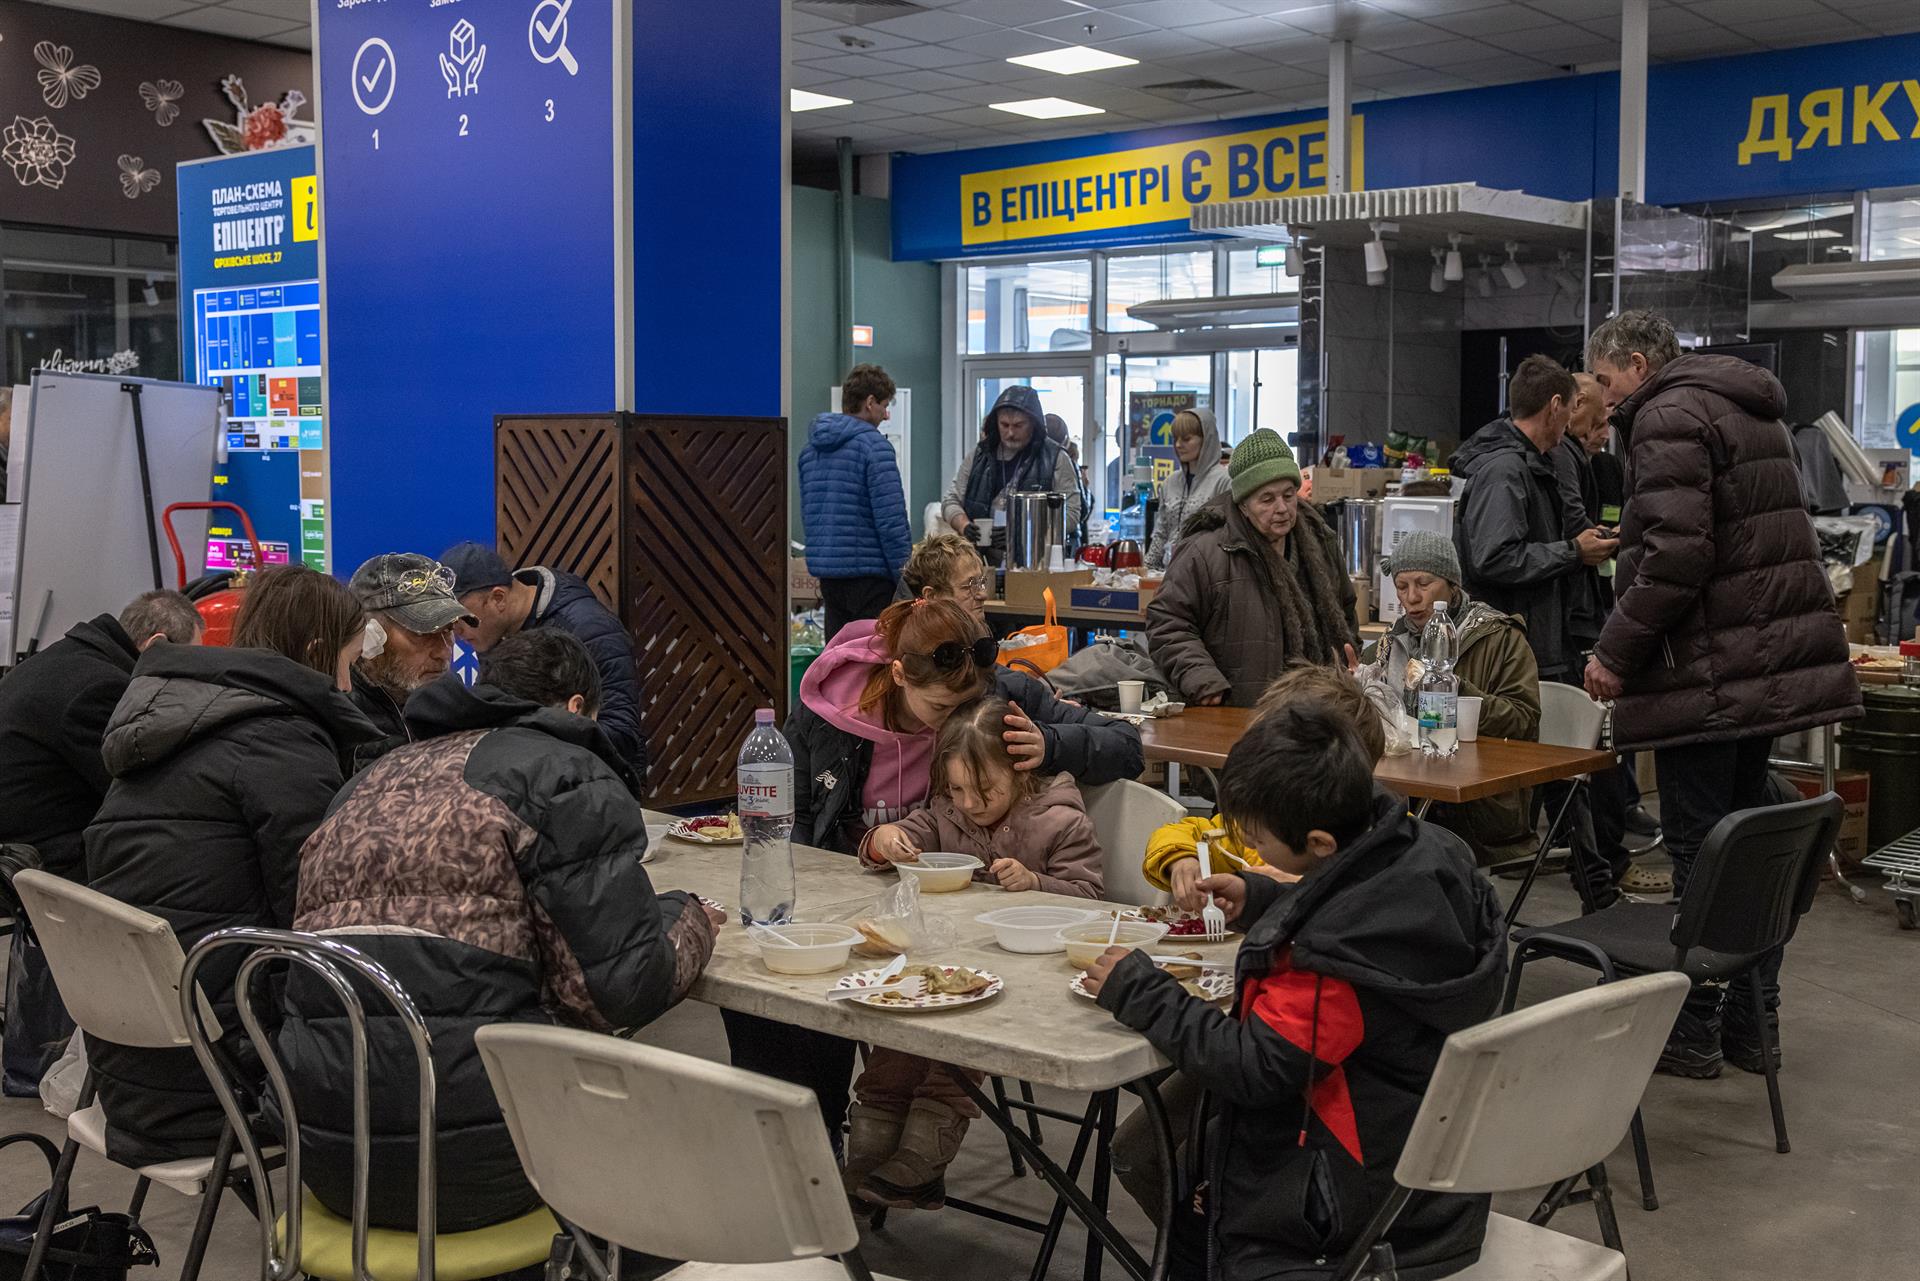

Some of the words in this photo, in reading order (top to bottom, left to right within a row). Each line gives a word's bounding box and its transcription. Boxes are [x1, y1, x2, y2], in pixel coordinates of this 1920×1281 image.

[544, 98, 555, 122] 3
[458, 113, 469, 136] 2
[371, 128, 380, 150] 1
[972, 191, 992, 227] В
[1001, 164, 1170, 222] ЕПІЦЕНТРІ
[1181, 149, 1212, 204] Є
[1228, 131, 1327, 199] ВСЕ
[212, 180, 283, 206] ПЛАН-СХЕМА
[213, 215, 285, 252] ЕПІЦЕНТР
[273, 251, 283, 263] 27
[1141, 395, 1187, 408] ТОРНАДО
